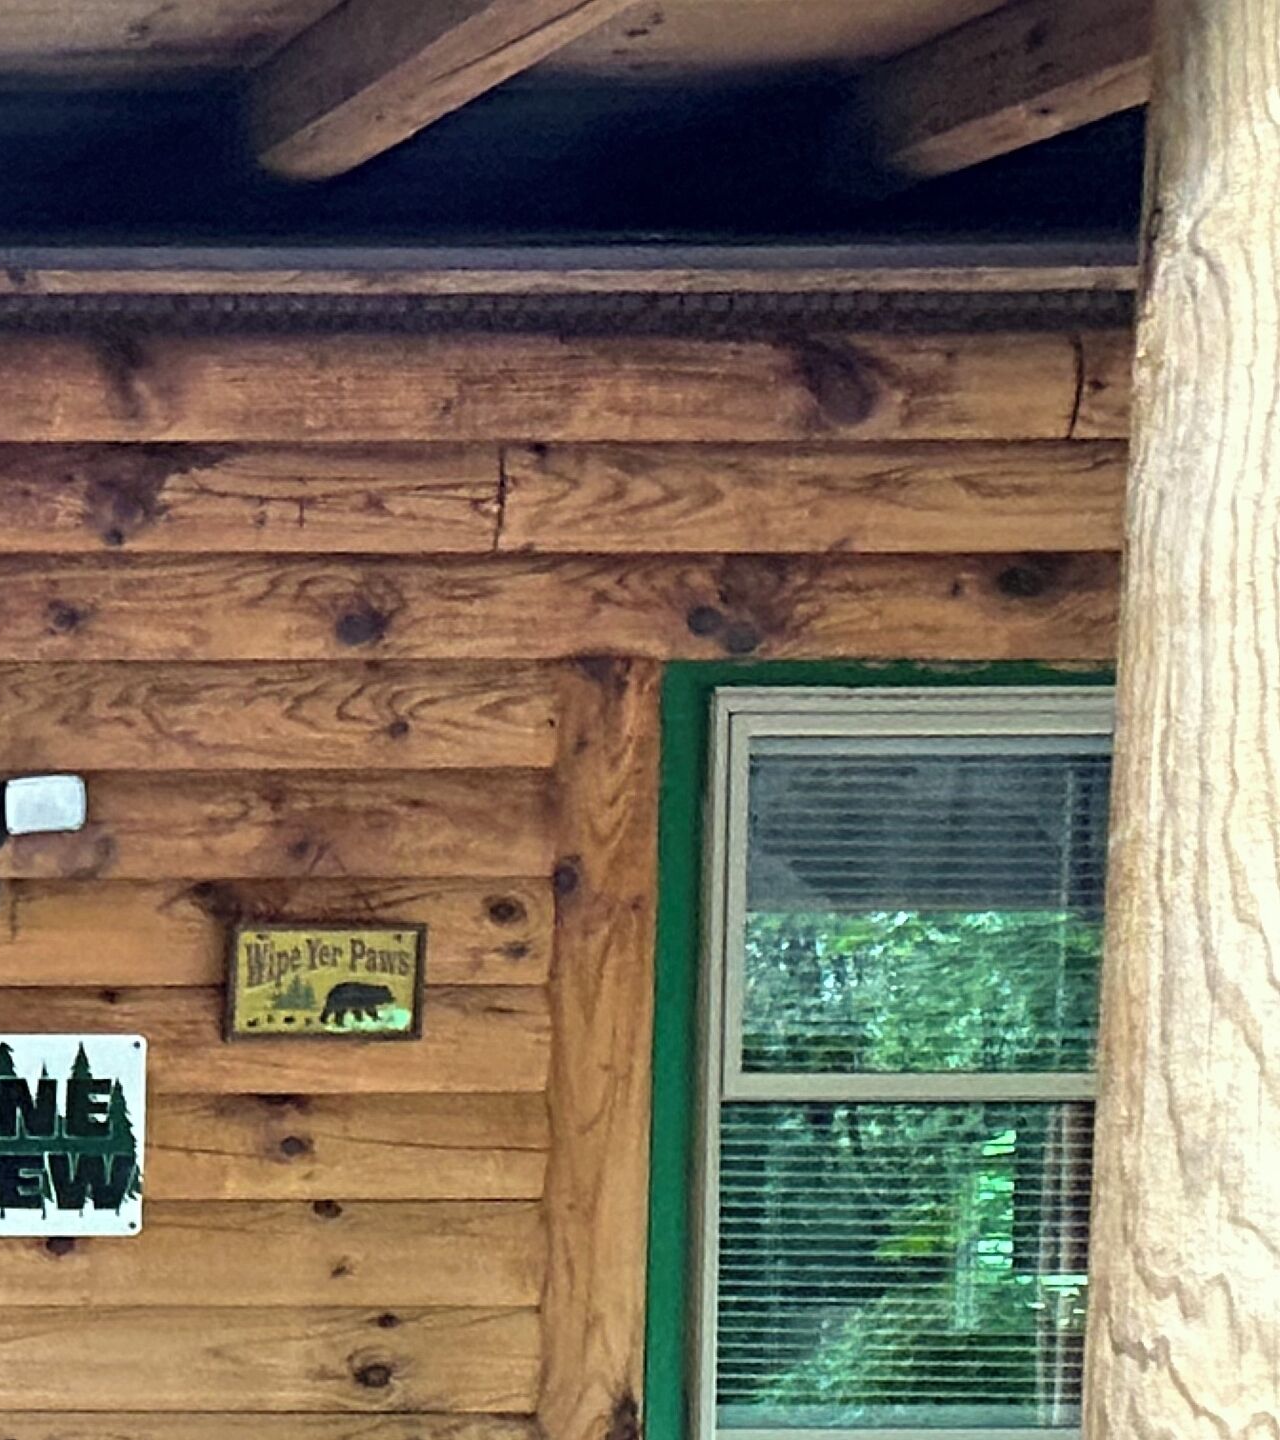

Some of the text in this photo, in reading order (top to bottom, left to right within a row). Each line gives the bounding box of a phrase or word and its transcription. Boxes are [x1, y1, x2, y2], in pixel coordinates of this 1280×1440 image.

[245, 937, 410, 991] Wipe Yer Paws
